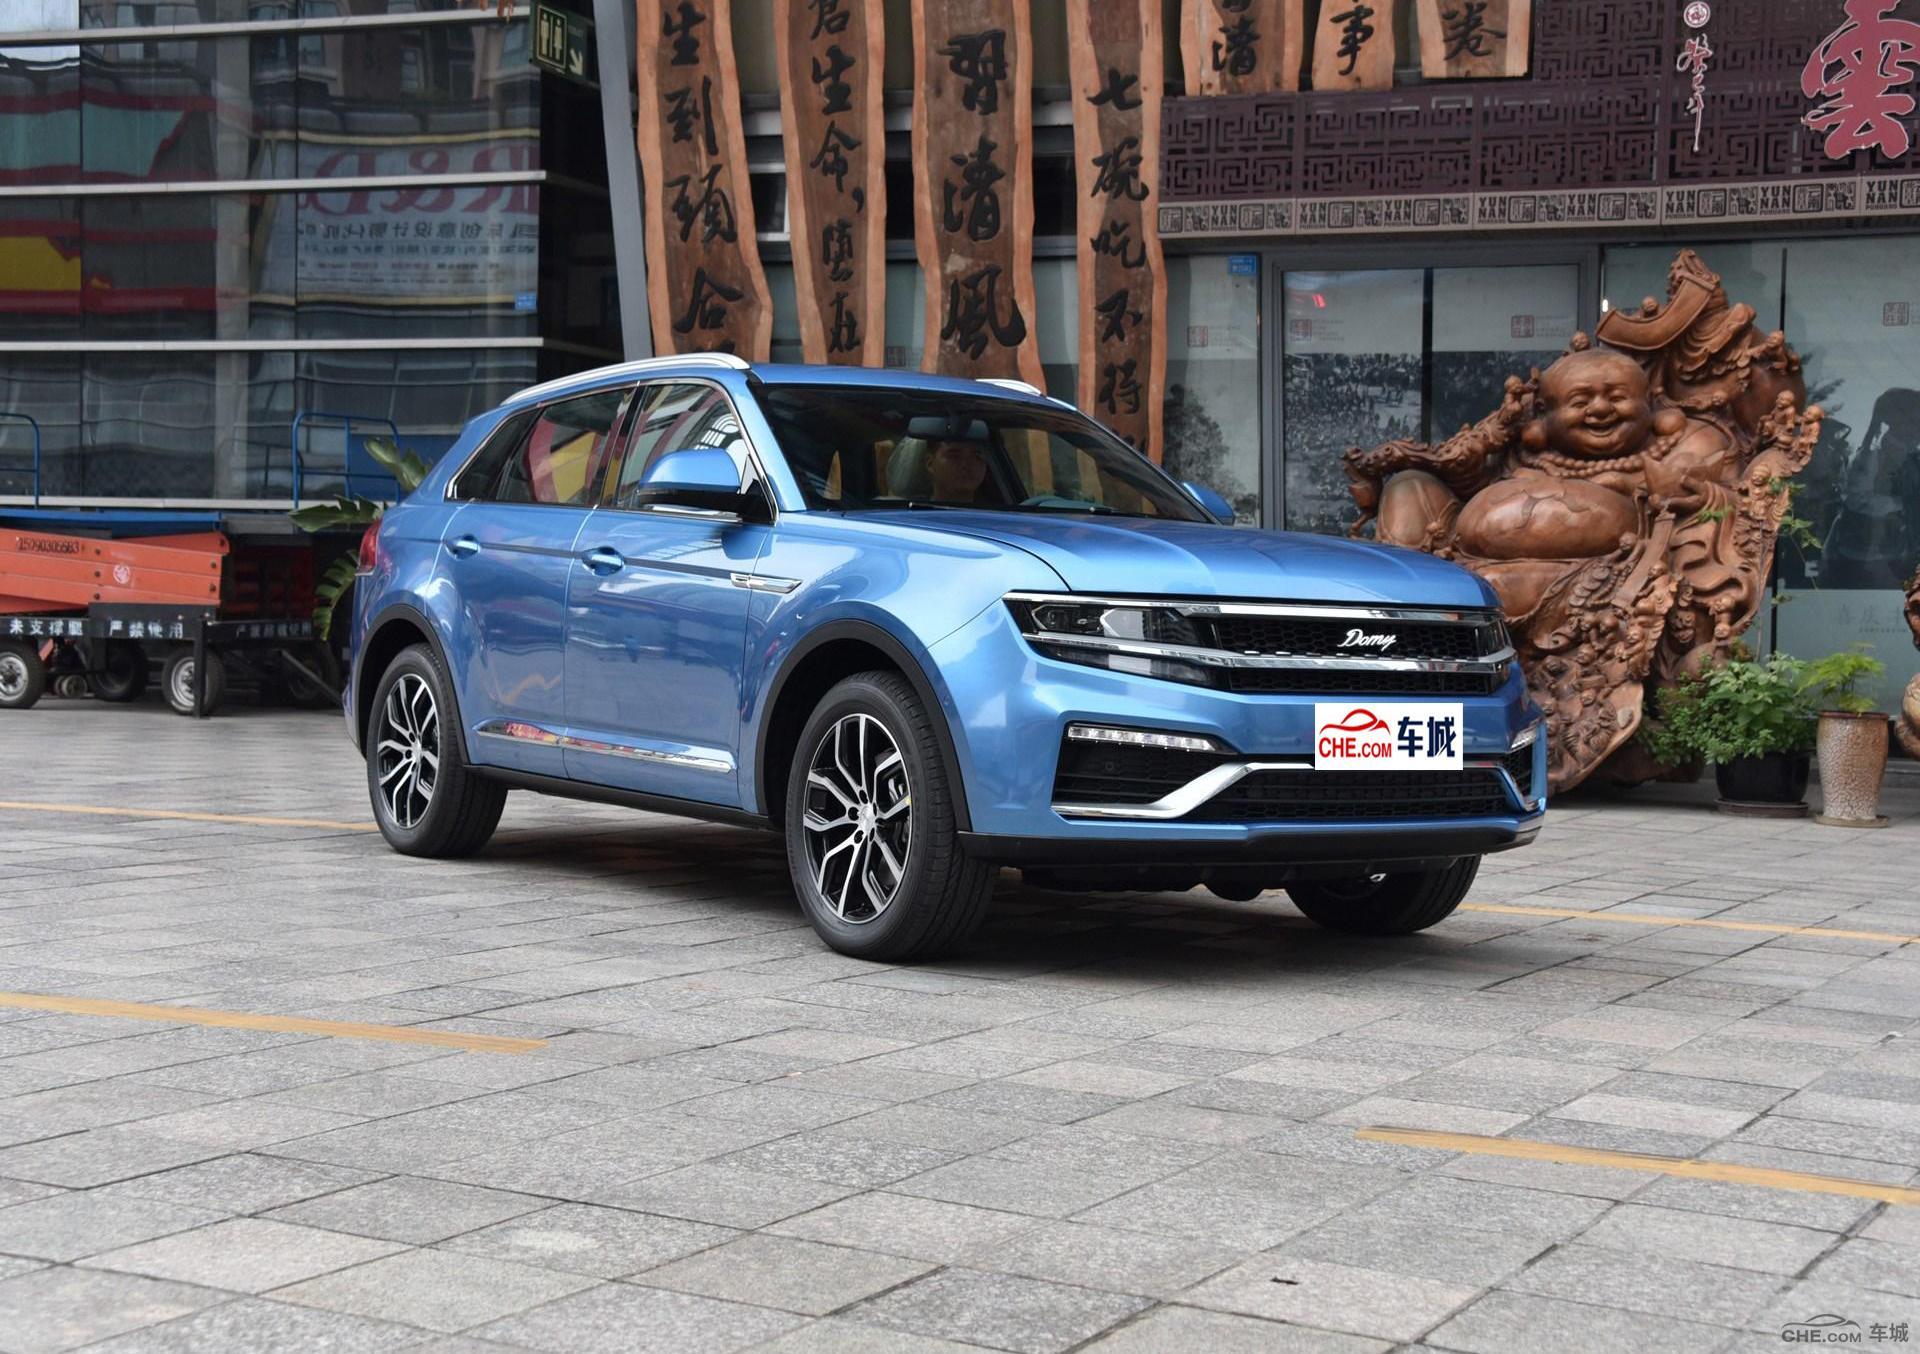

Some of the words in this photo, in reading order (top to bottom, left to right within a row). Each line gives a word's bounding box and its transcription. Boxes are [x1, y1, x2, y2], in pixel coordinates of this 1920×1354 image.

[1212, 0, 1262, 76] 清
[1760, 185, 1791, 197] YUN
[1866, 180, 1899, 192] YUN
[1479, 196, 1507, 208] YUN
[1567, 193, 1596, 205] YUN
[1666, 190, 1696, 202] YUN
[1866, 192, 1898, 204] NAN
[1300, 202, 1326, 214] YUN
[1384, 199, 1412, 211] YUN
[1665, 202, 1696, 213] NAN
[1760, 197, 1791, 209] NAN
[1211, 205, 1237, 216] YUN
[1384, 210, 1412, 222] NAN
[1478, 207, 1506, 218] NAN
[1567, 204, 1596, 217] NAN
[1211, 216, 1237, 226] NAN
[1300, 212, 1326, 225] NAN
[1086, 68, 1150, 453] 七碗吃不得
[1337, 628, 1397, 652] Domy
